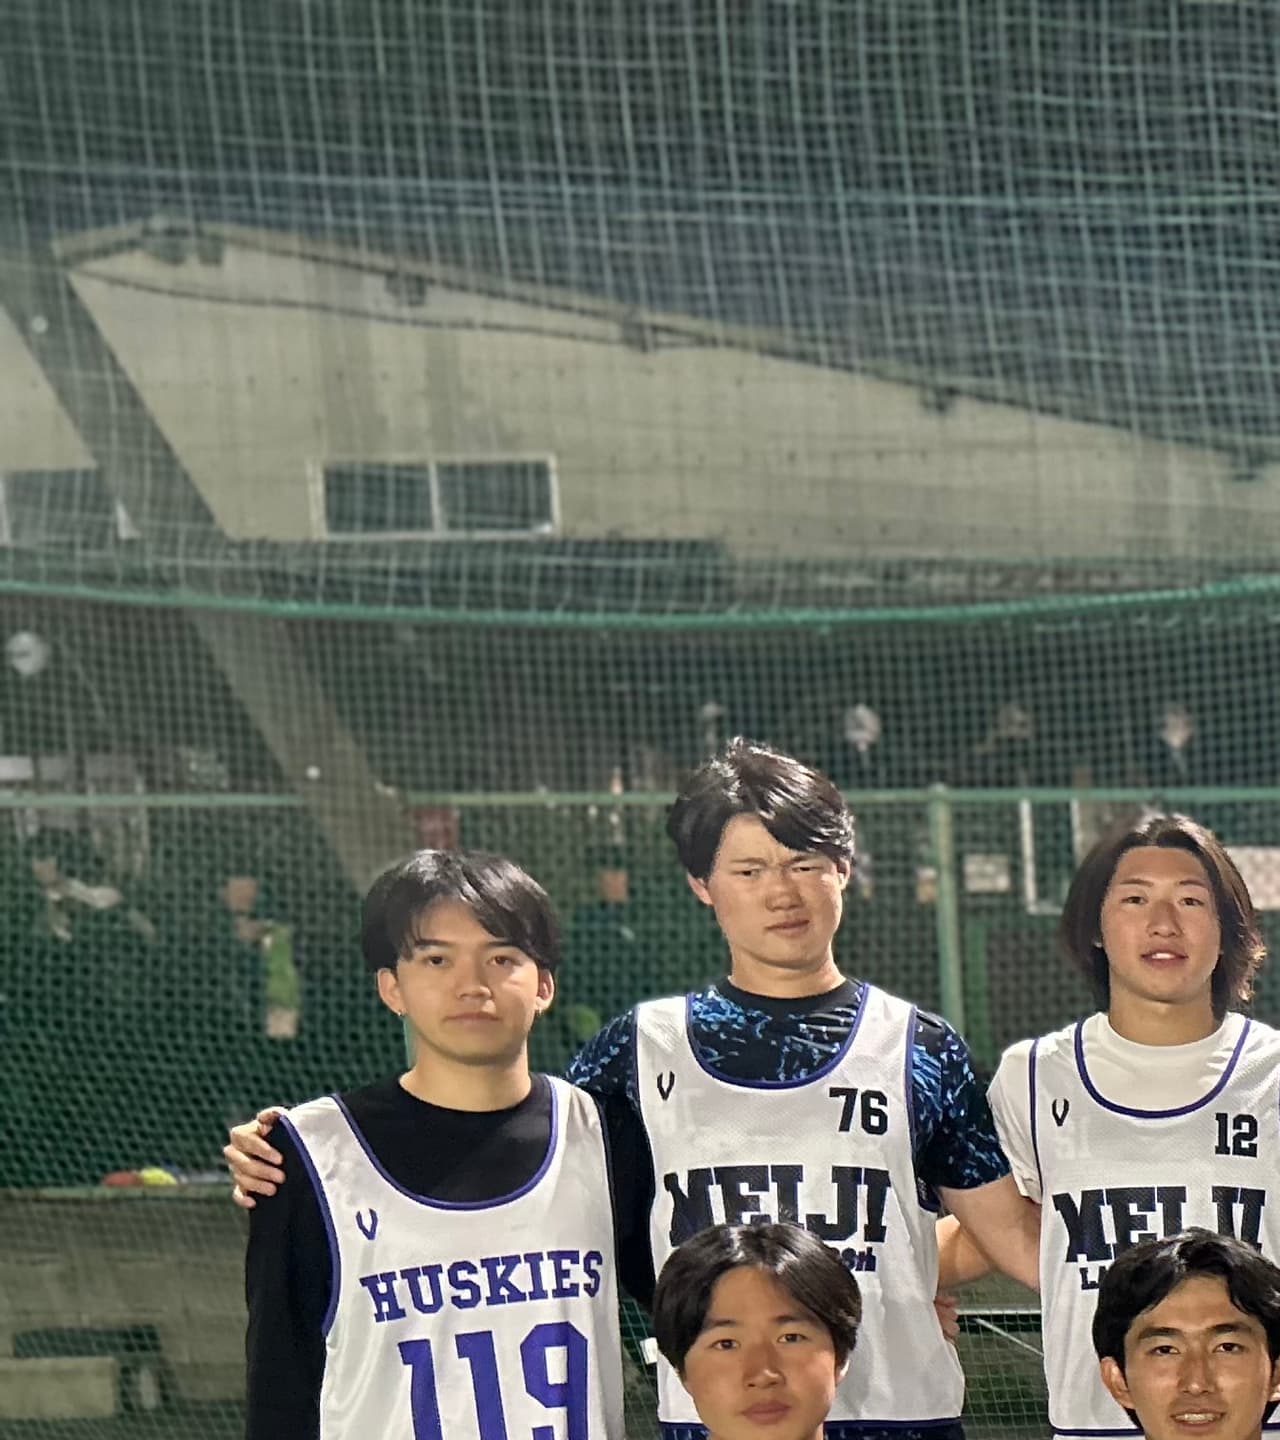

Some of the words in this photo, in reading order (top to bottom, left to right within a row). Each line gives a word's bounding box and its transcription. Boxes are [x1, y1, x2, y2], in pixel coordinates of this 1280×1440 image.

[829, 1087, 888, 1135] 76
[1215, 1112, 1258, 1158] 12
[359, 1250, 603, 1323] HUSKIES
